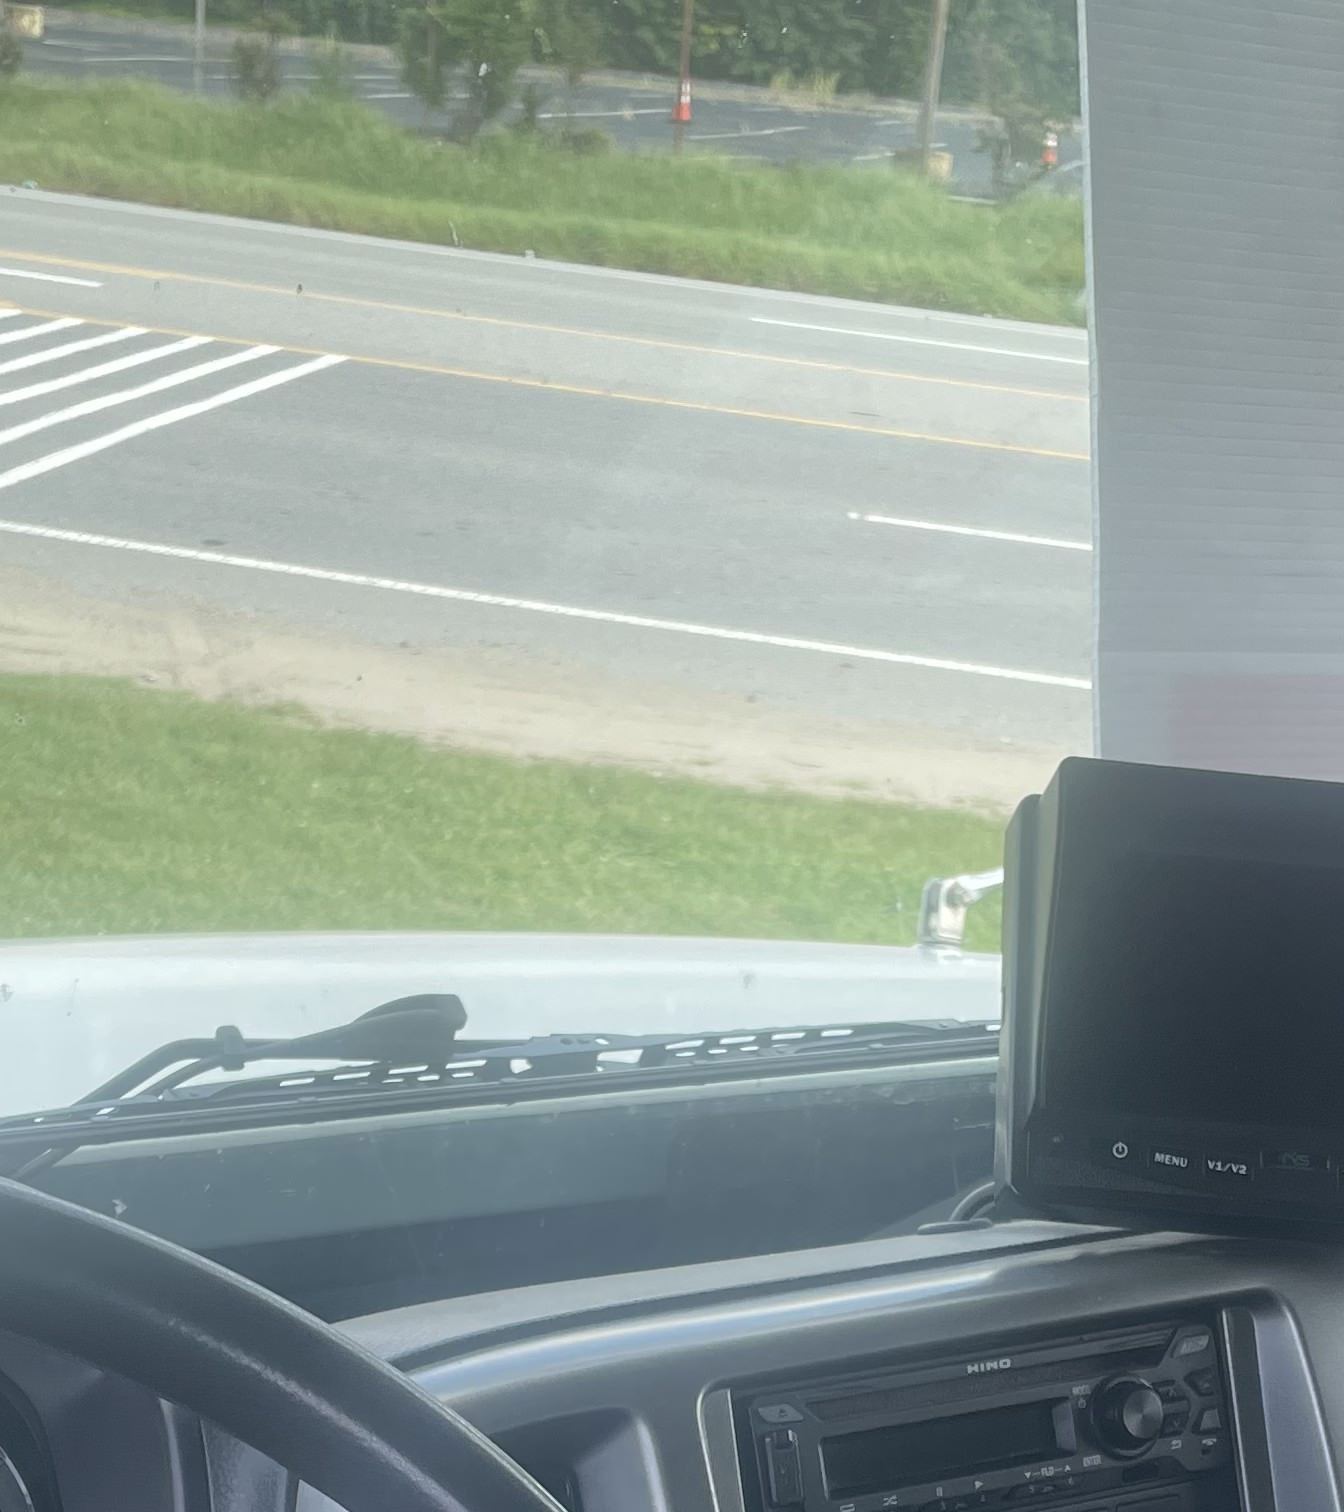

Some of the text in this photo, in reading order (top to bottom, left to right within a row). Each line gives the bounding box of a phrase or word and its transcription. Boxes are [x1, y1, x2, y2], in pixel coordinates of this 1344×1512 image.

[1154, 1152, 1188, 1169] MENU
[1207, 1159, 1248, 1176] V1/V2
[966, 1357, 1012, 1375] HINO
